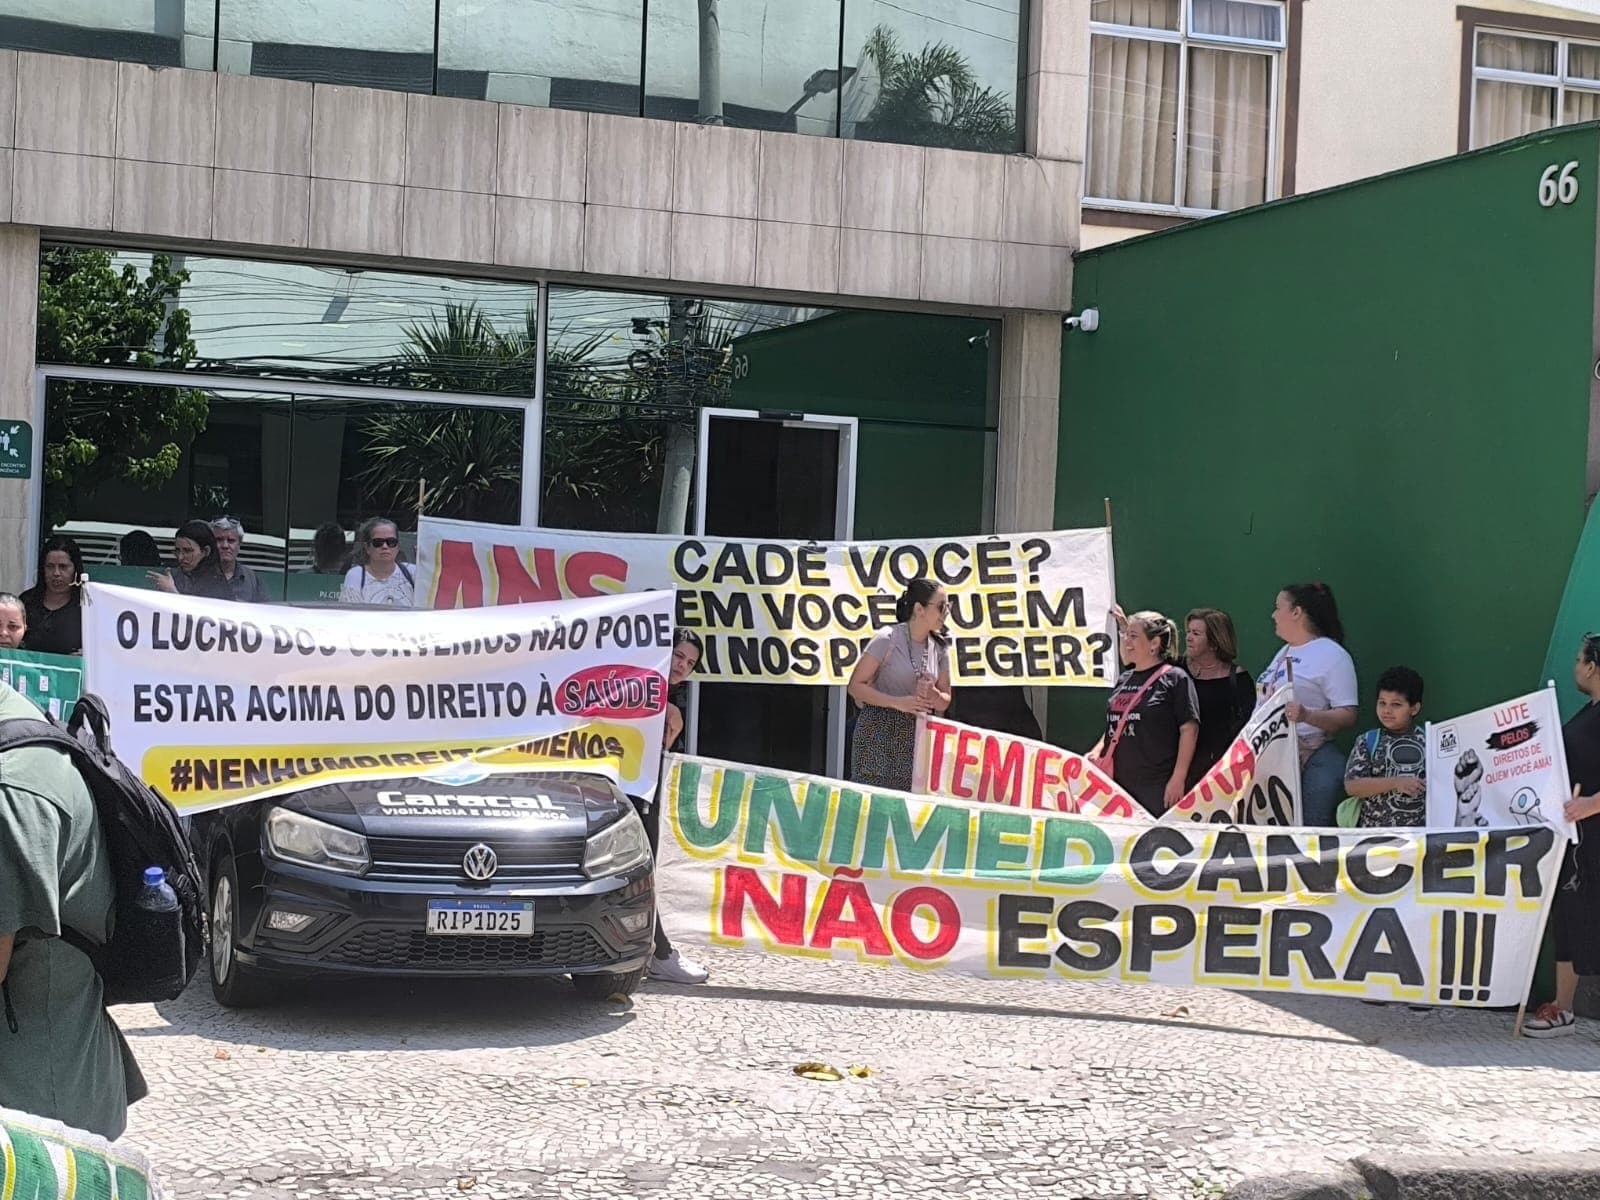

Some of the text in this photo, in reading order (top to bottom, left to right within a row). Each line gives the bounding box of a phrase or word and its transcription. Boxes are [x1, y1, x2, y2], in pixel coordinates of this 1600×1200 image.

[1538, 160, 1579, 207] 66
[434, 540, 629, 611] ANS
[674, 536, 1052, 588] CADÊ VOCÊ?
[117, 610, 140, 650] O
[152, 611, 263, 653] LUCRO
[529, 614, 589, 653] NÃO
[595, 613, 672, 649] PODE
[675, 586, 1087, 635] EM VOCÊ UEM
[727, 636, 822, 676] NOS
[134, 669, 662, 723] ESTAR ACIMA DO DIREITO À SAÚDE
[1493, 702, 1531, 728] LUTE
[1493, 743, 1543, 767] DIREITOS DE
[1501, 727, 1530, 746] PELOS
[927, 721, 1024, 808] TEM
[1485, 755, 1553, 785] QUEM VOCÊ AMA!
[382, 807, 571, 820] VIGILÂNCIA E SEGURANÇA
[678, 762, 1555, 899] UNIMED CÂNCER
[437, 911, 521, 931] RIP1D25
[721, 865, 1498, 1002] NÃO ESPERA!!!
